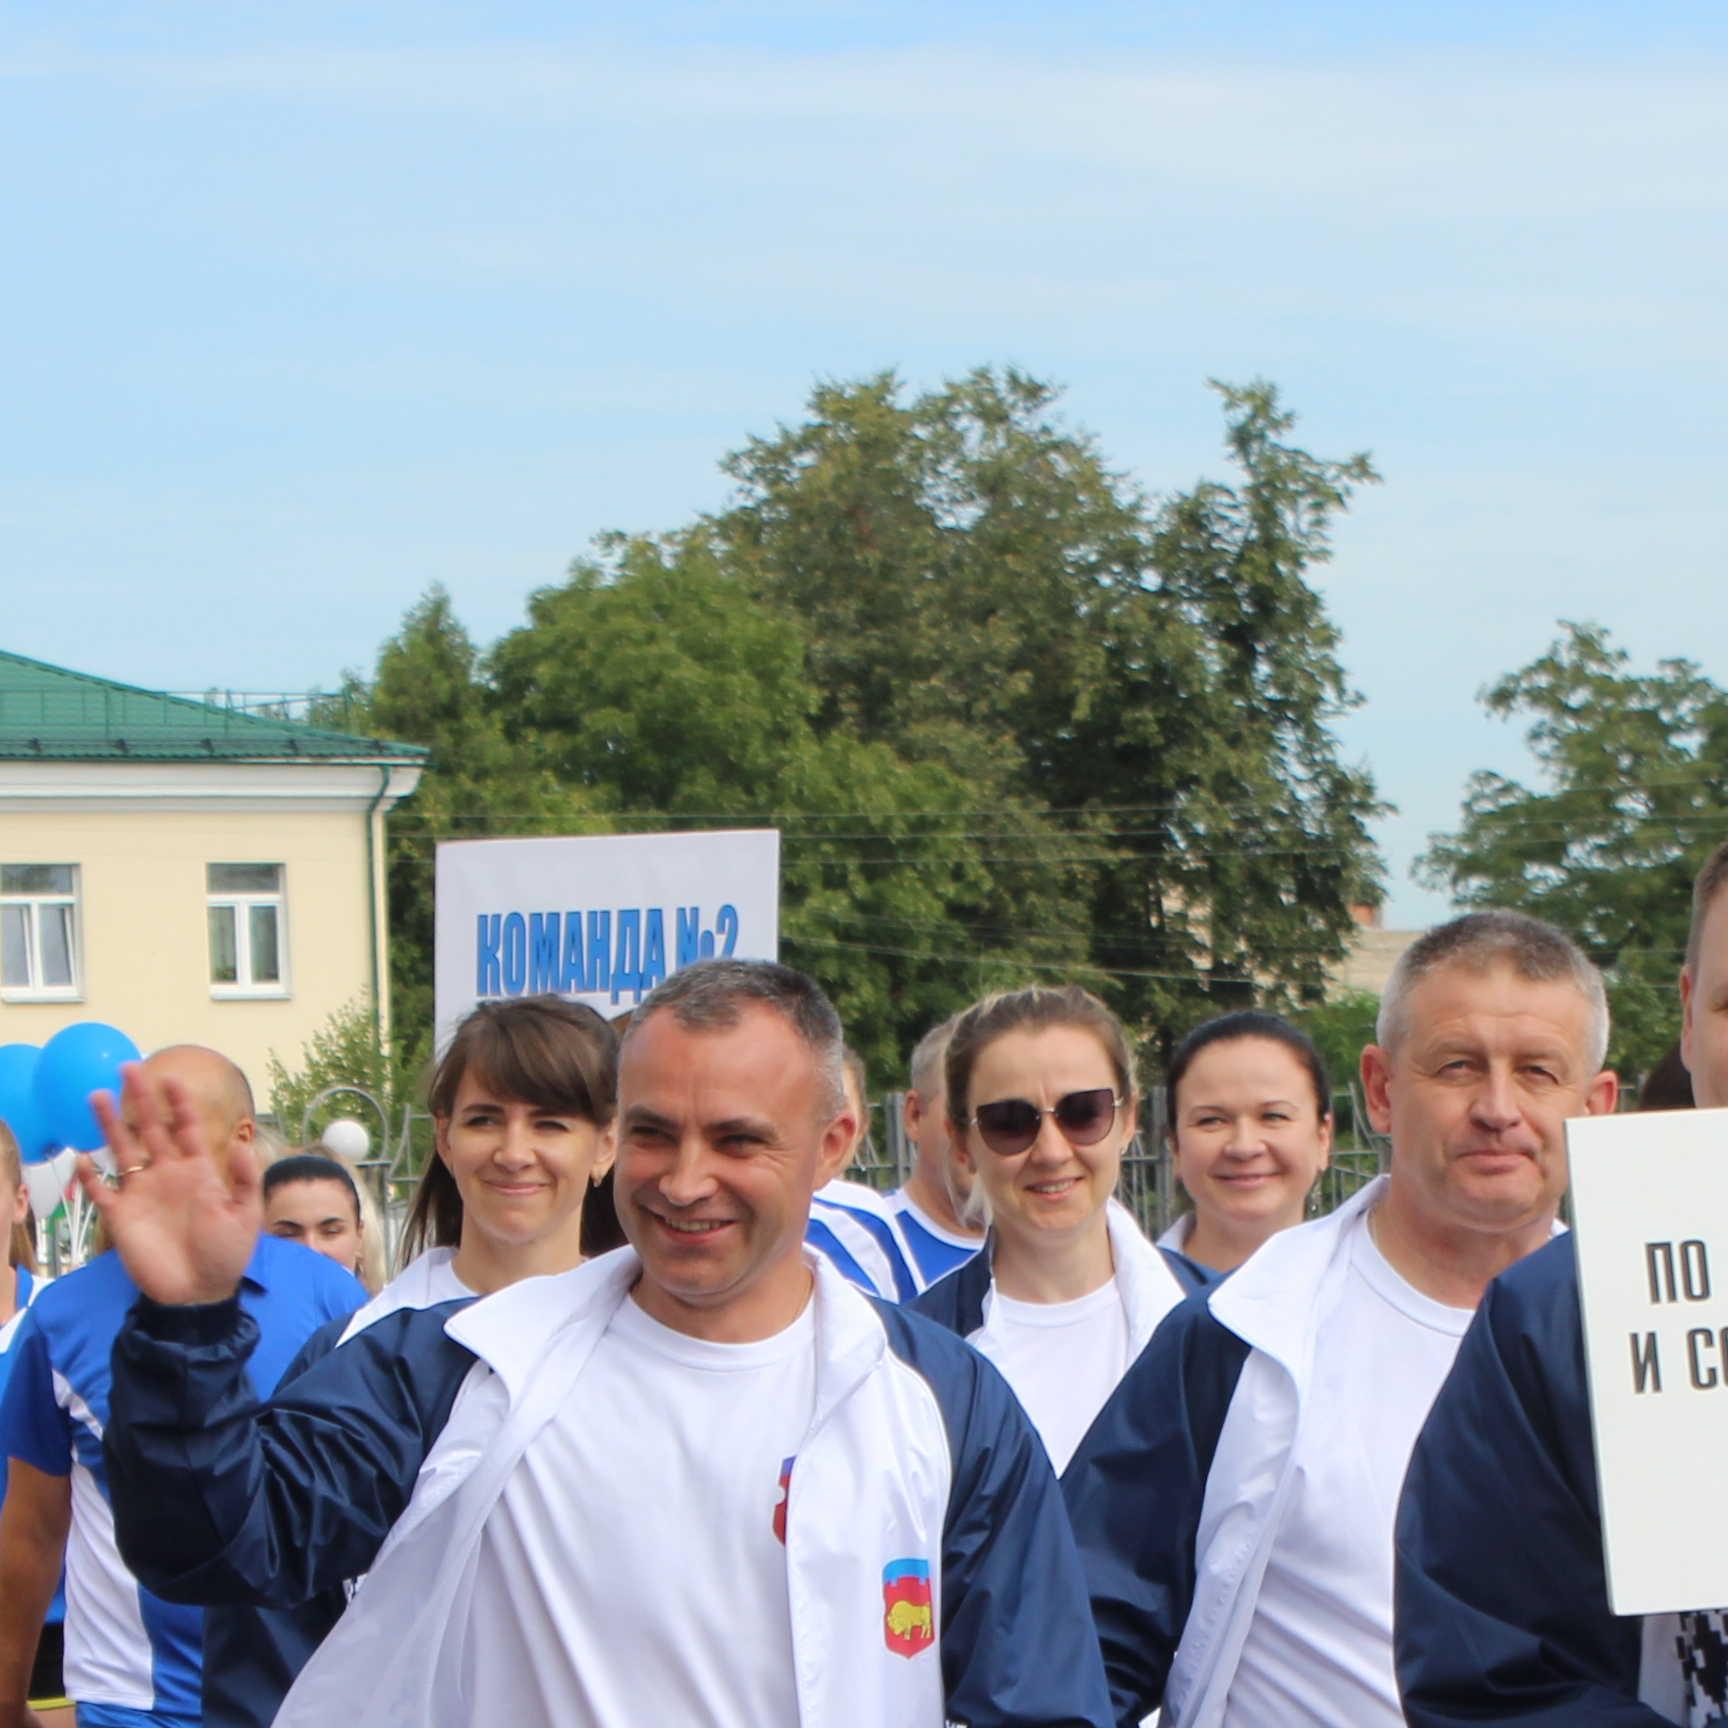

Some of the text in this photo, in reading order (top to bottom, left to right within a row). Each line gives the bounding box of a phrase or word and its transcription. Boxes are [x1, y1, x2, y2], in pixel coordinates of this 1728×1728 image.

[476, 908, 666, 1005] КОМАНДА
[1645, 1239, 1712, 1304] ПО
[1630, 1331, 1662, 1394] И
